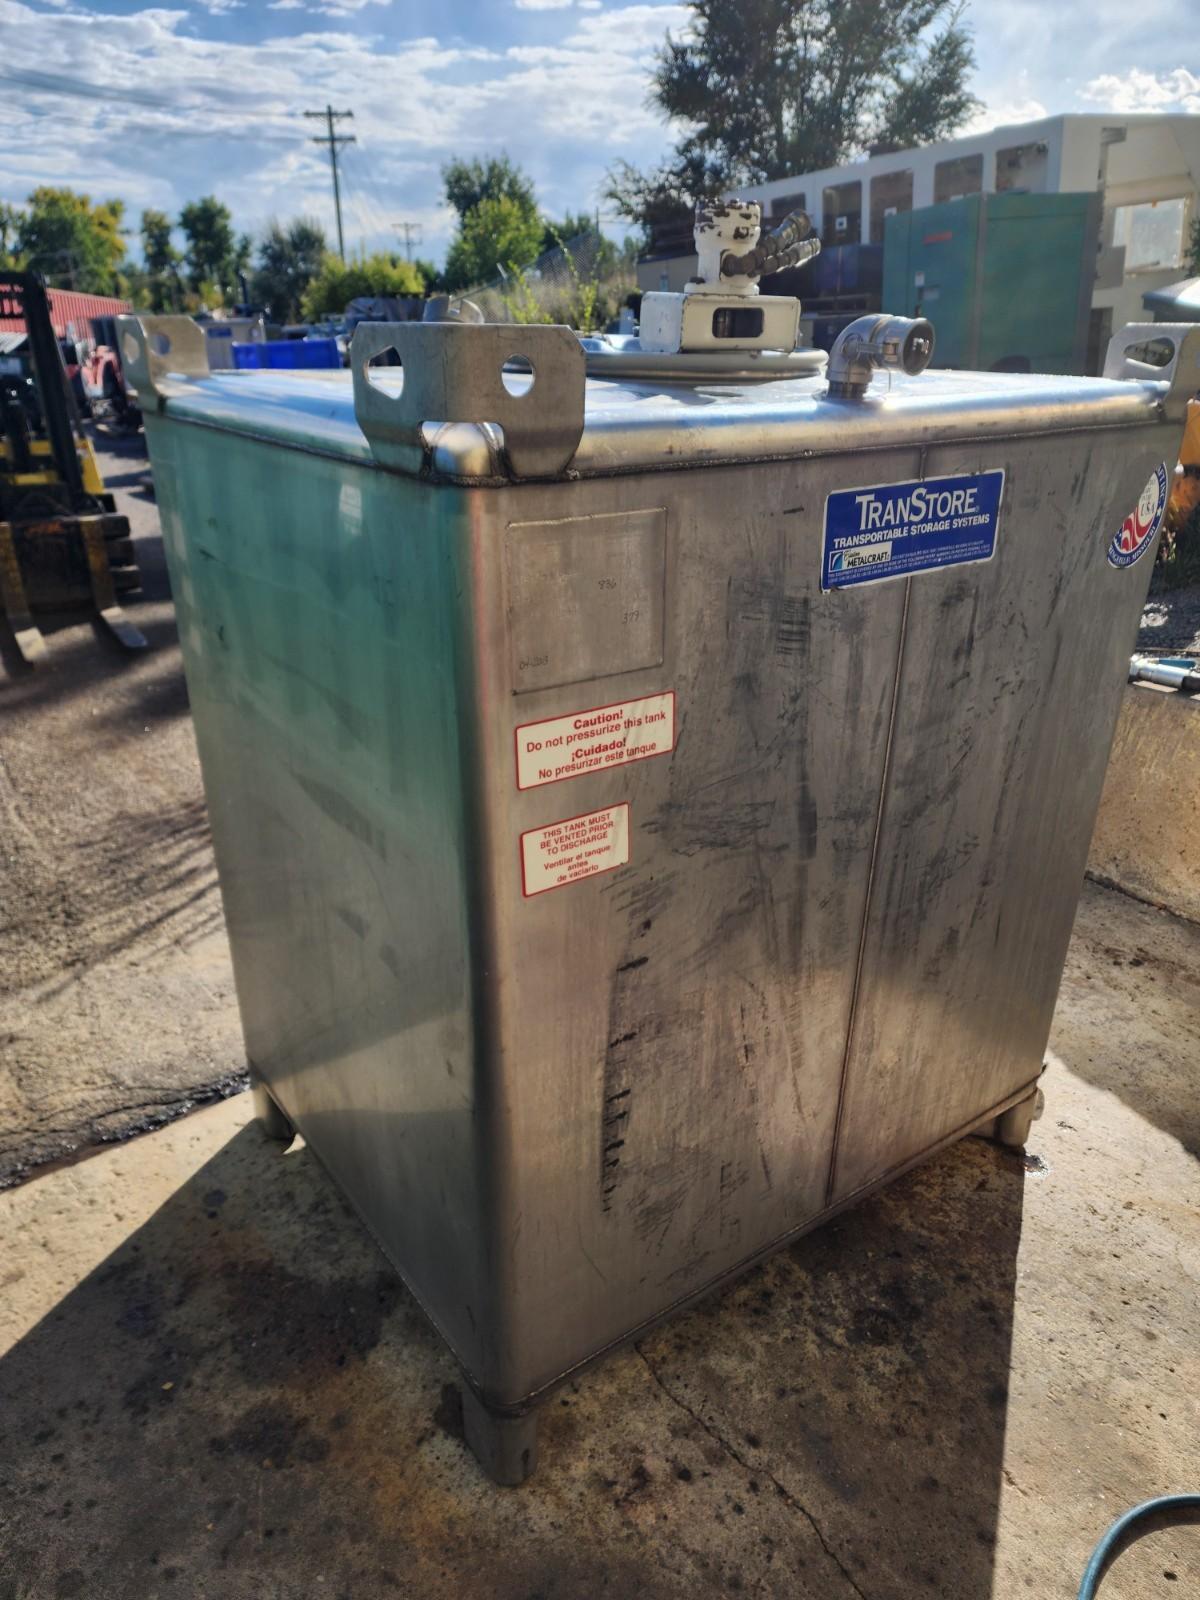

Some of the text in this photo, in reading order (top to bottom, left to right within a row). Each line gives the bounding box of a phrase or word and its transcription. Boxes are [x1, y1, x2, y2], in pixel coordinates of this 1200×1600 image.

[833, 513, 990, 549] TRANSPORTABLE STORAGE SYSTEMS
[846, 553, 888, 568] METALCRAFT
[526, 711, 666, 753] Do not pressurize this tank
[573, 709, 624, 730] Caution!
[538, 742, 656, 779] No presurizar este tanque
[571, 737, 627, 762] ¡Cuidado!
[540, 821, 614, 849] BE VENTED PRIOR
[543, 813, 611, 839] THIS TANK MUST
[547, 831, 608, 855] TO DISCHARGE
[544, 845, 611, 871] Ventilar el tanque
[567, 860, 589, 871] antes
[557, 864, 599, 883] de vaciarlo
